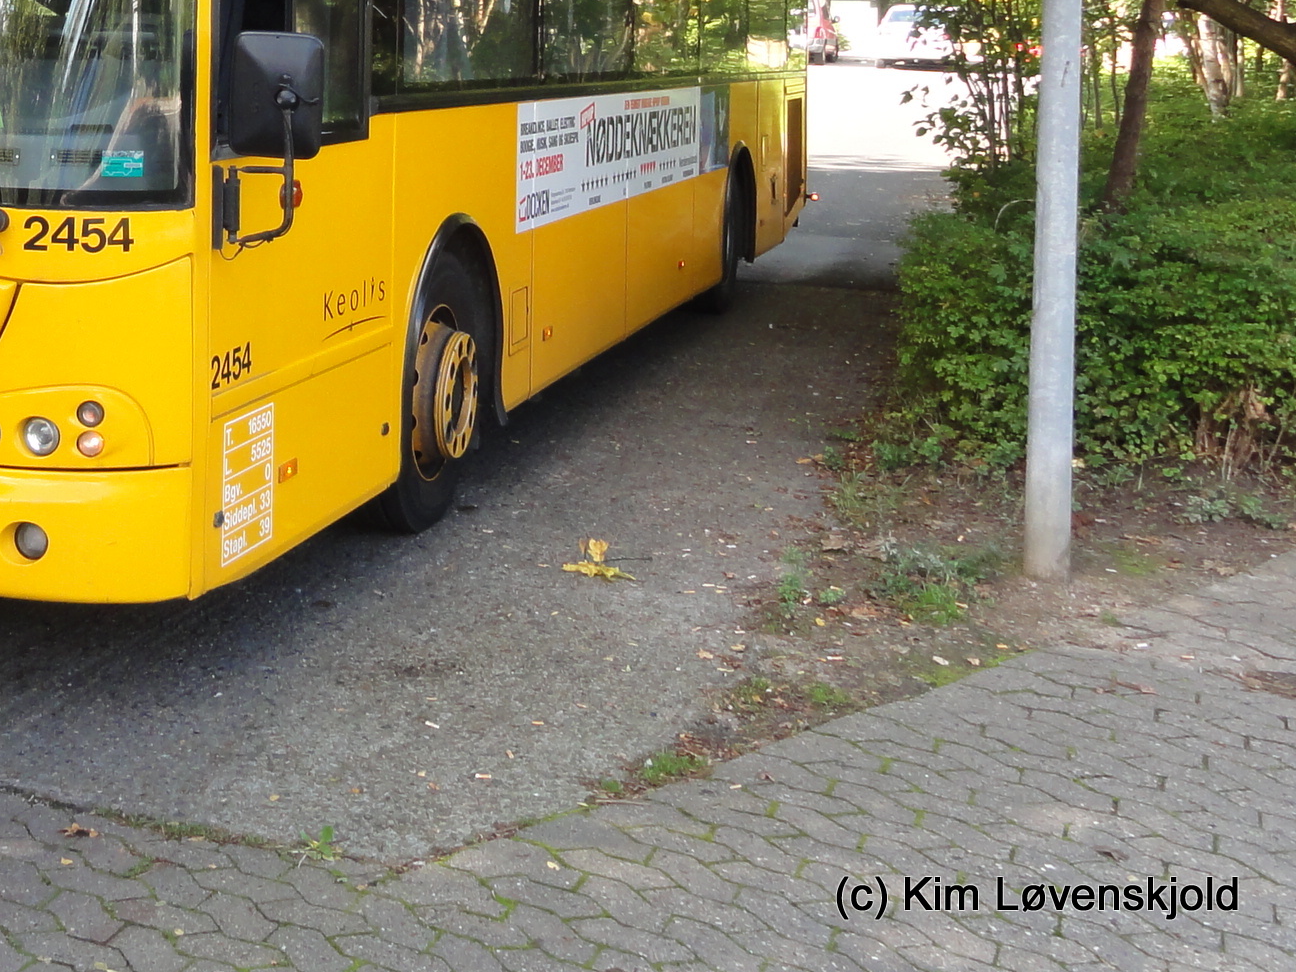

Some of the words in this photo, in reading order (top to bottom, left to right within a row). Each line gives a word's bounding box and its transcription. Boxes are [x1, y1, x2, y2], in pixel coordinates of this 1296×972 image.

[585, 105, 697, 168] NØDDEKNÆKKEREN
[23, 217, 134, 253] 2454
[323, 276, 386, 321] Keolis
[211, 341, 252, 389] 2454
[248, 410, 272, 435] 16550
[251, 437, 272, 462] 5525
[224, 483, 243, 505] Bgv.
[264, 463, 271, 481] 0
[224, 497, 257, 530] Siddepl.
[260, 489, 271, 511] 33
[259, 516, 270, 538] 39
